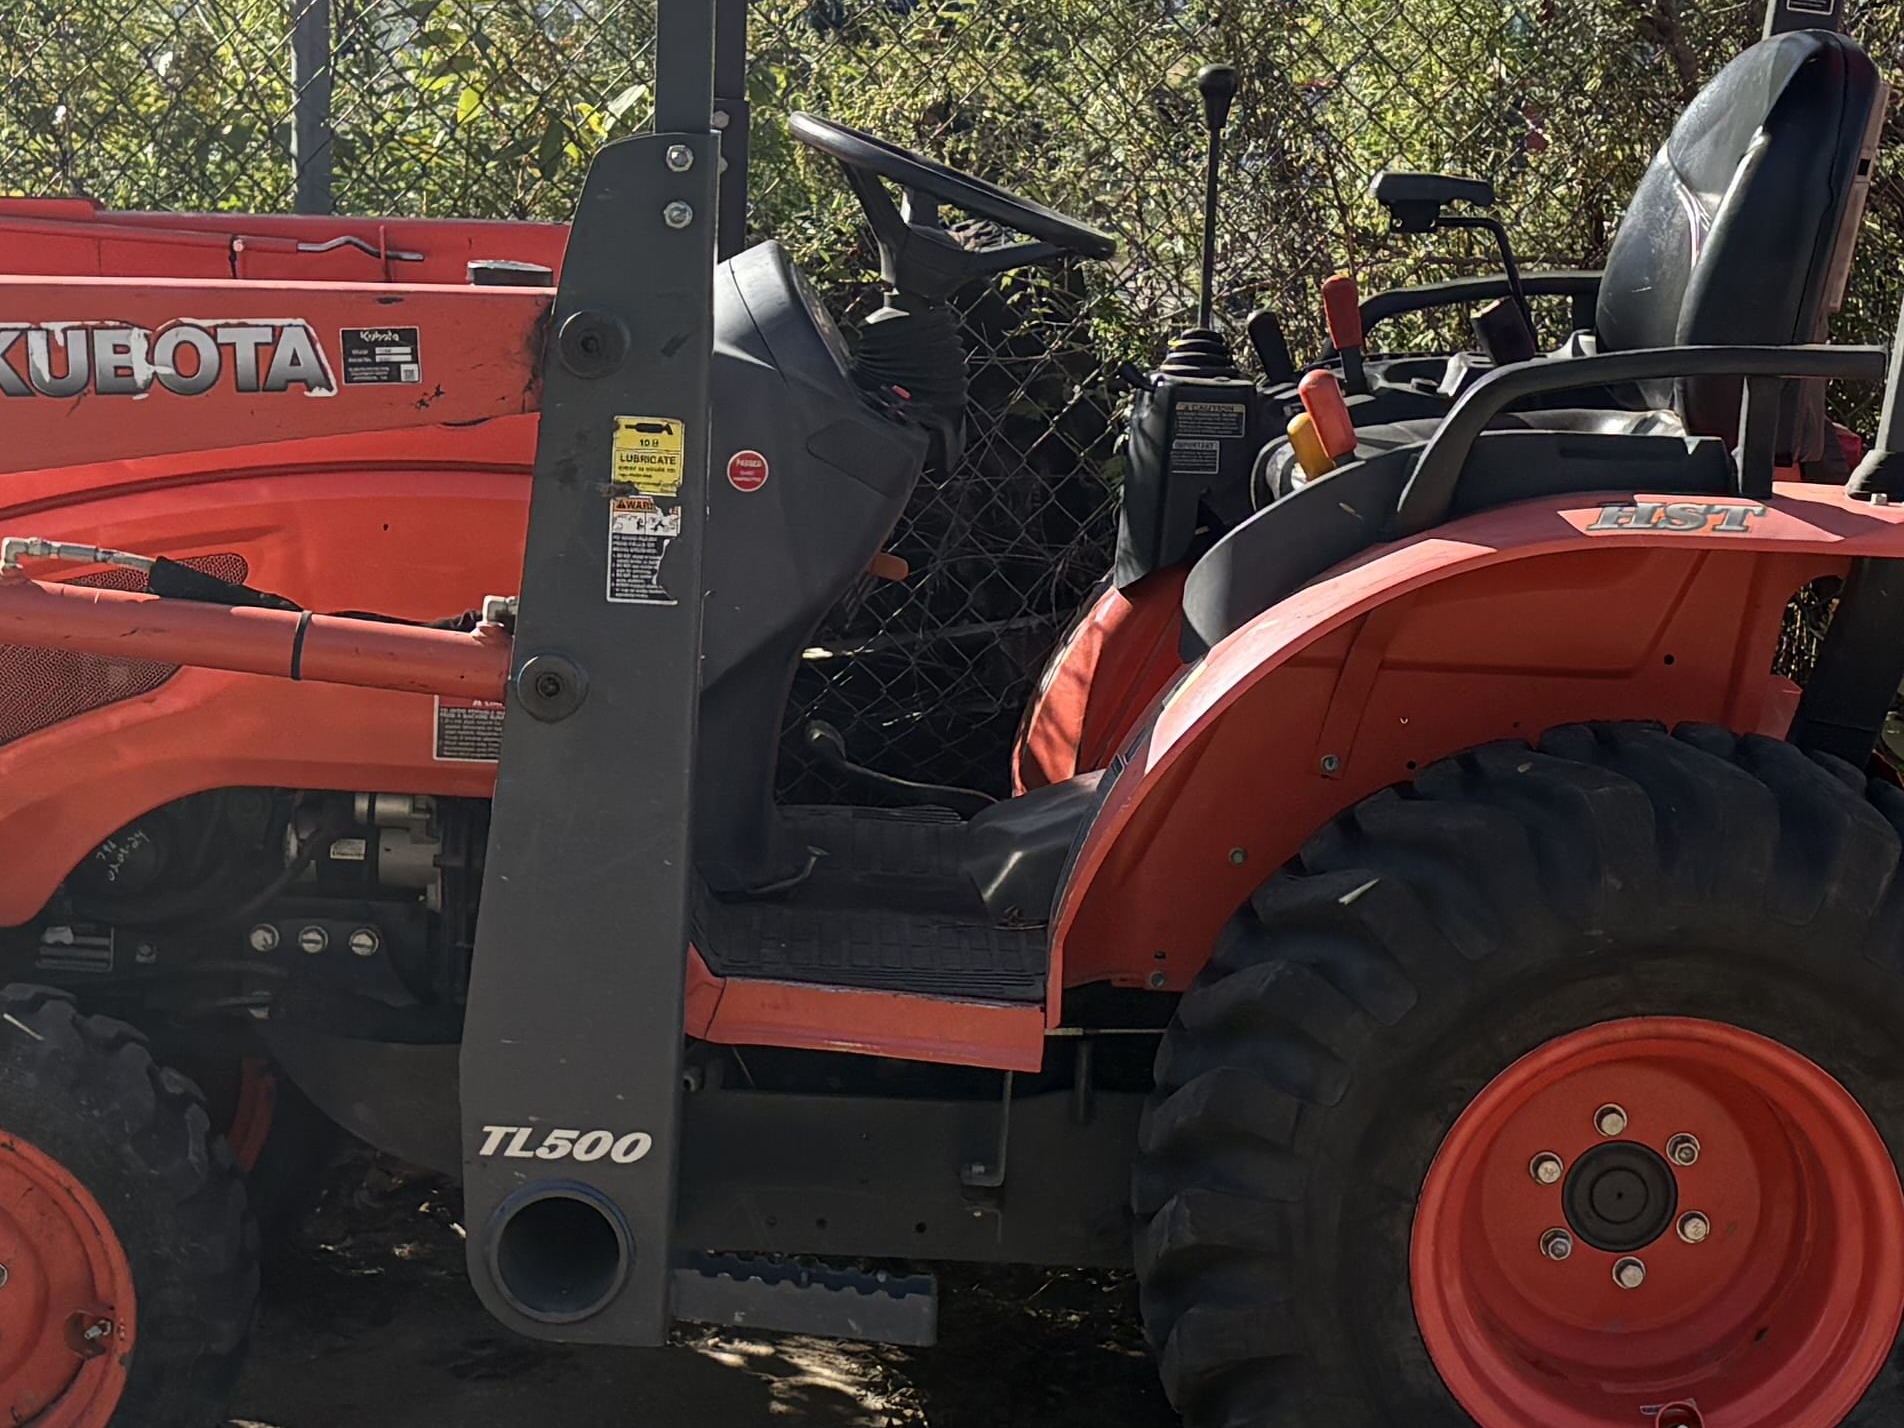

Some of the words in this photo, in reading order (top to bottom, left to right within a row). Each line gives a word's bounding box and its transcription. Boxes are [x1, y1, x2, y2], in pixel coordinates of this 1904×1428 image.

[639, 439, 650, 447] 10
[620, 453, 677, 465] LUBRICATE
[1587, 501, 1767, 532] HST
[479, 1125, 652, 1164] TL500
